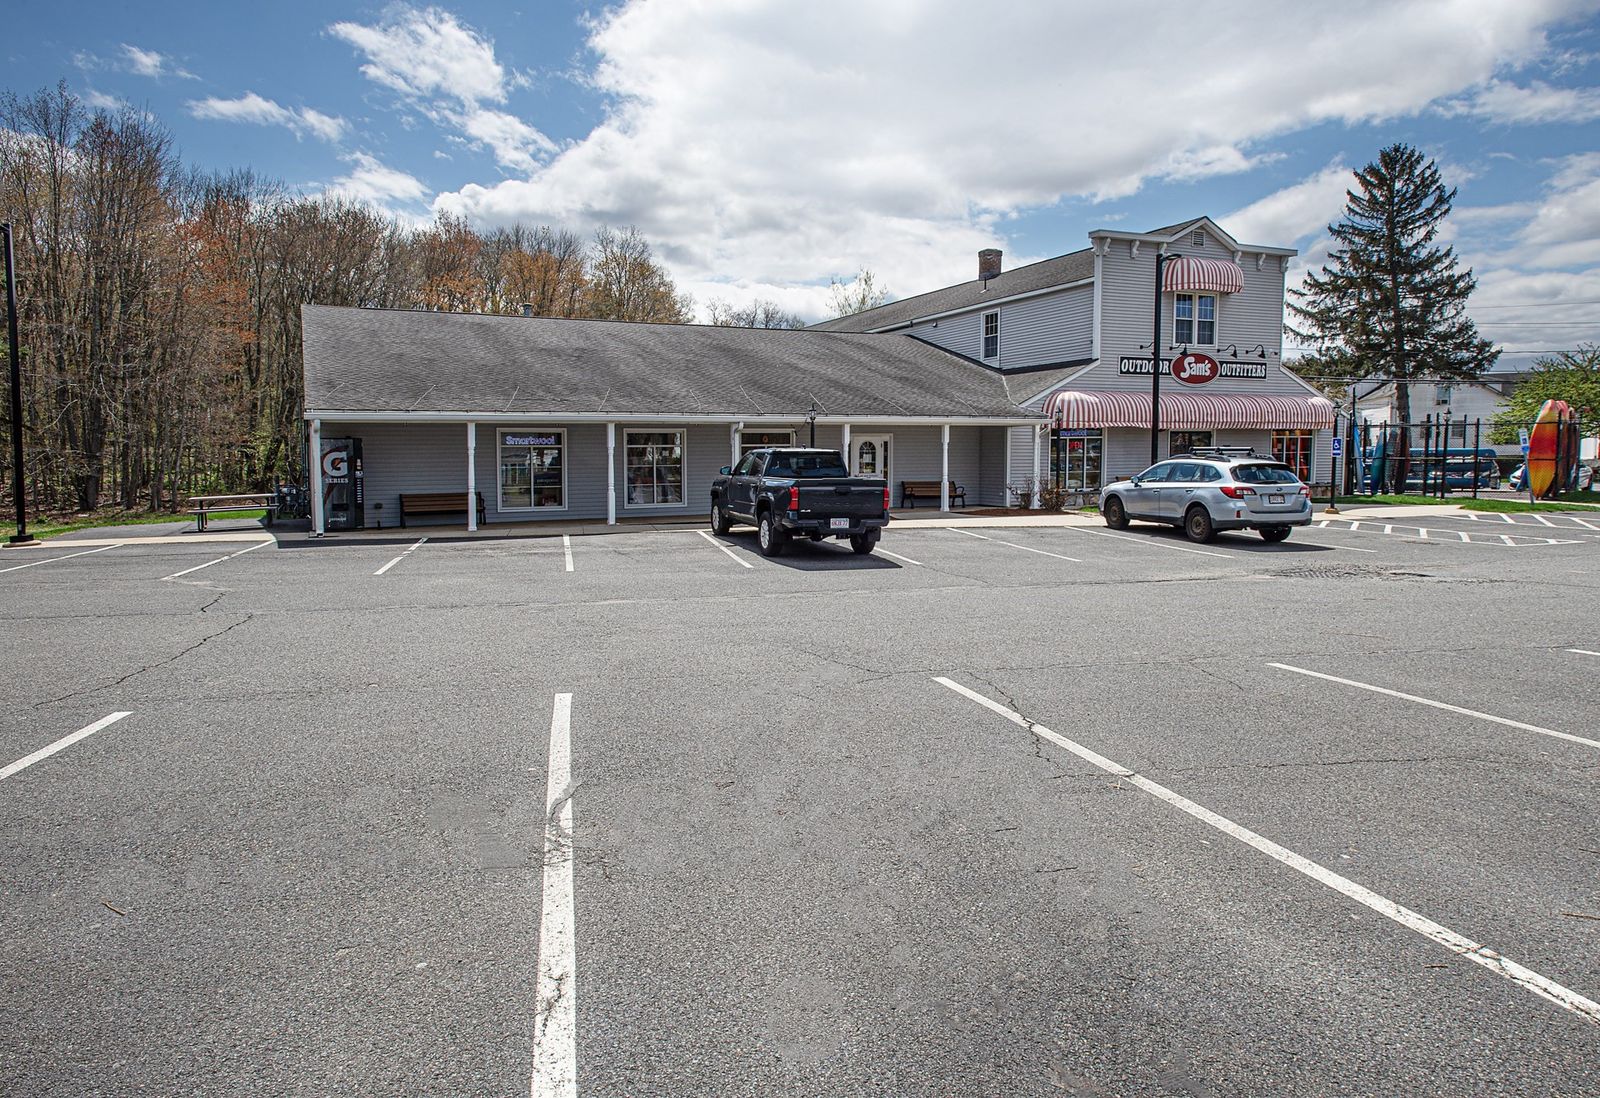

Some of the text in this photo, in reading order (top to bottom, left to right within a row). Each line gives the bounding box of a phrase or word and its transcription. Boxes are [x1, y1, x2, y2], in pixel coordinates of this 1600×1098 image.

[1180, 356, 1212, 379] Sam's
[1221, 362, 1266, 377] OUTFITTERS
[505, 435, 555, 445] Smartwool
[323, 451, 348, 477] G
